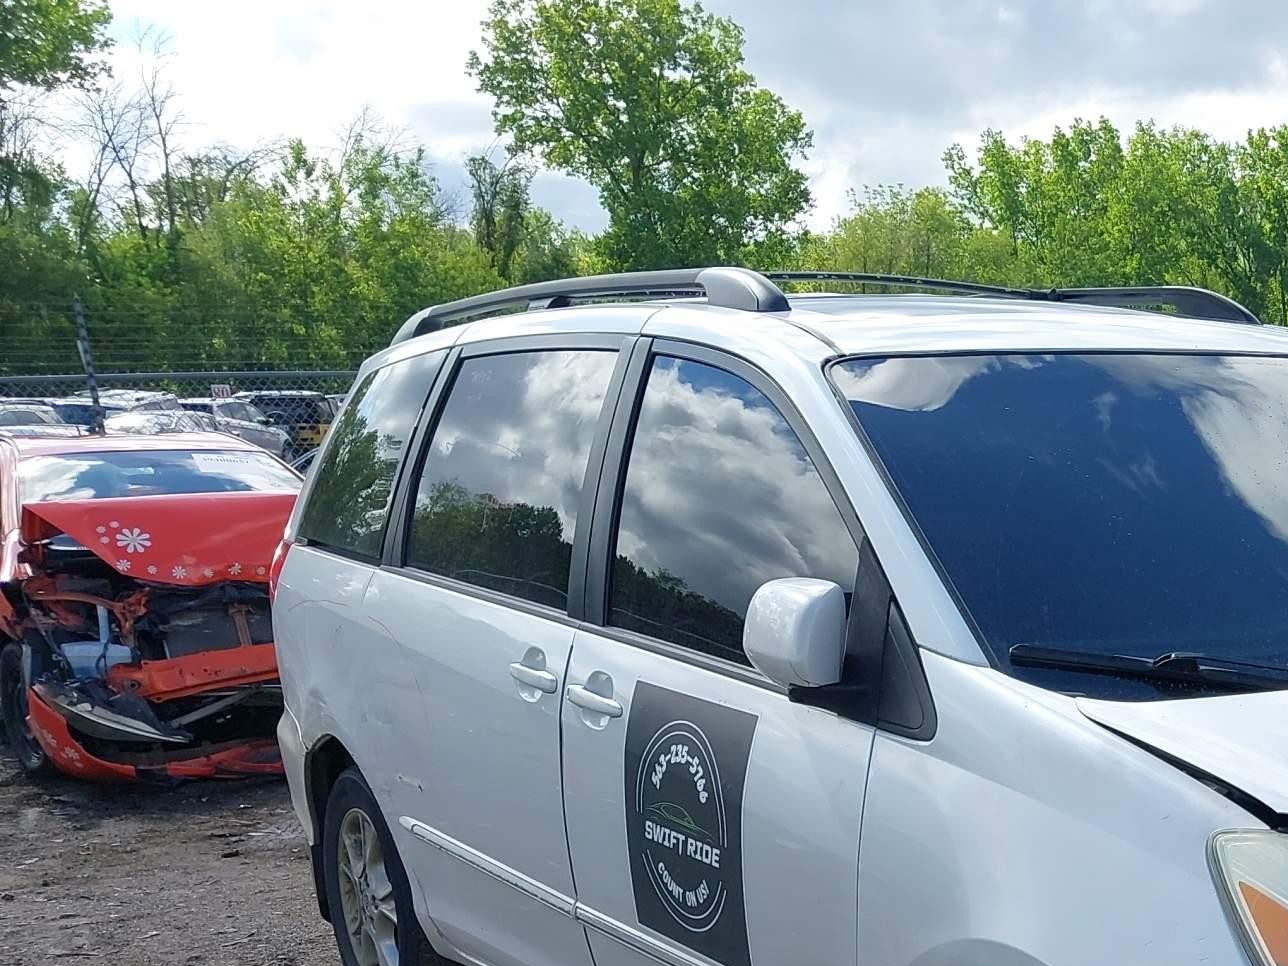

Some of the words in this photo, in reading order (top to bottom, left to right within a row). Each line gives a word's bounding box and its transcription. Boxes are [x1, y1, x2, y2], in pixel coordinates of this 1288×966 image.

[651, 743, 708, 805] 563-235-5766
[644, 820, 686, 856] SWIFT
[687, 840, 720, 868] RIDE
[658, 862, 684, 903] COUNT
[686, 889, 698, 908] ON
